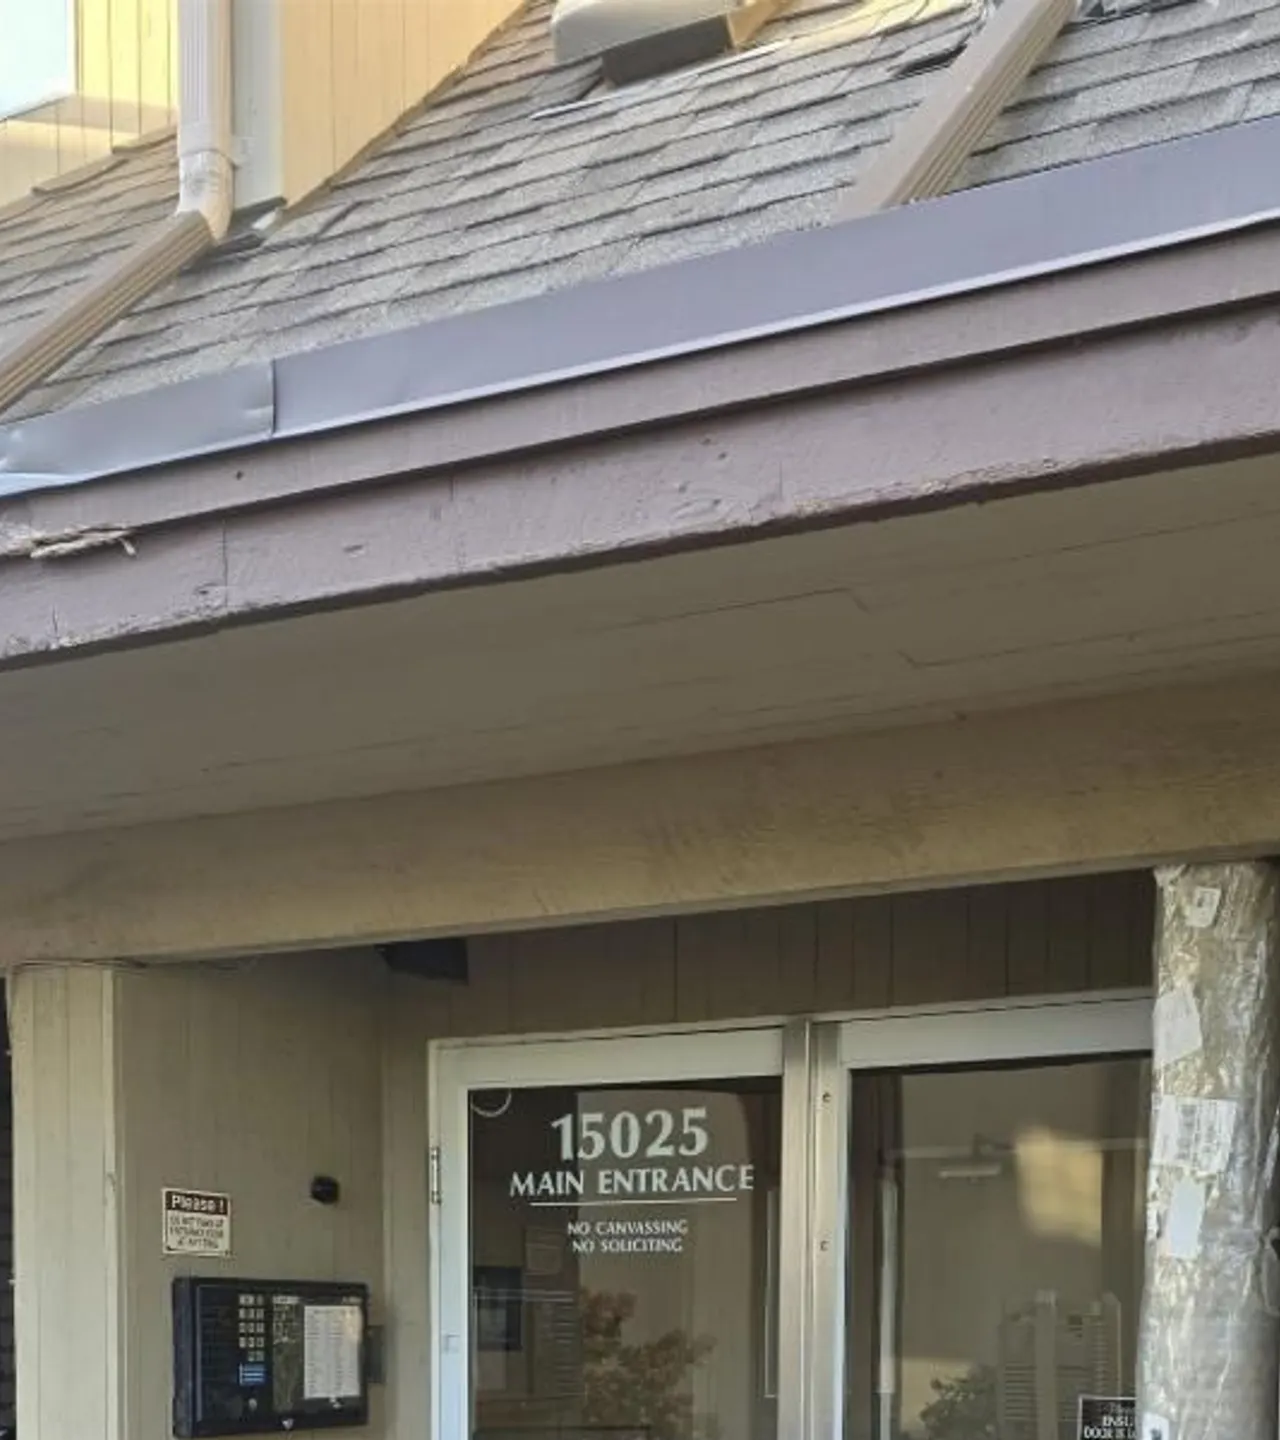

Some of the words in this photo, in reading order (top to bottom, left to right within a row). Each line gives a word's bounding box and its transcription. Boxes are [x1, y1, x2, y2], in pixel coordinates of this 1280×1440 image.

[551, 1106, 708, 1161] 15025
[510, 1171, 584, 1197] MAIN
[598, 1165, 754, 1195] ENTRANCE
[172, 1195, 216, 1212] Please
[567, 1221, 591, 1235] NO
[595, 1219, 688, 1235] CANVASSING
[572, 1239, 595, 1252] NO
[601, 1237, 683, 1252] SOLICITING
[1084, 1426, 1111, 1439] DOOR
